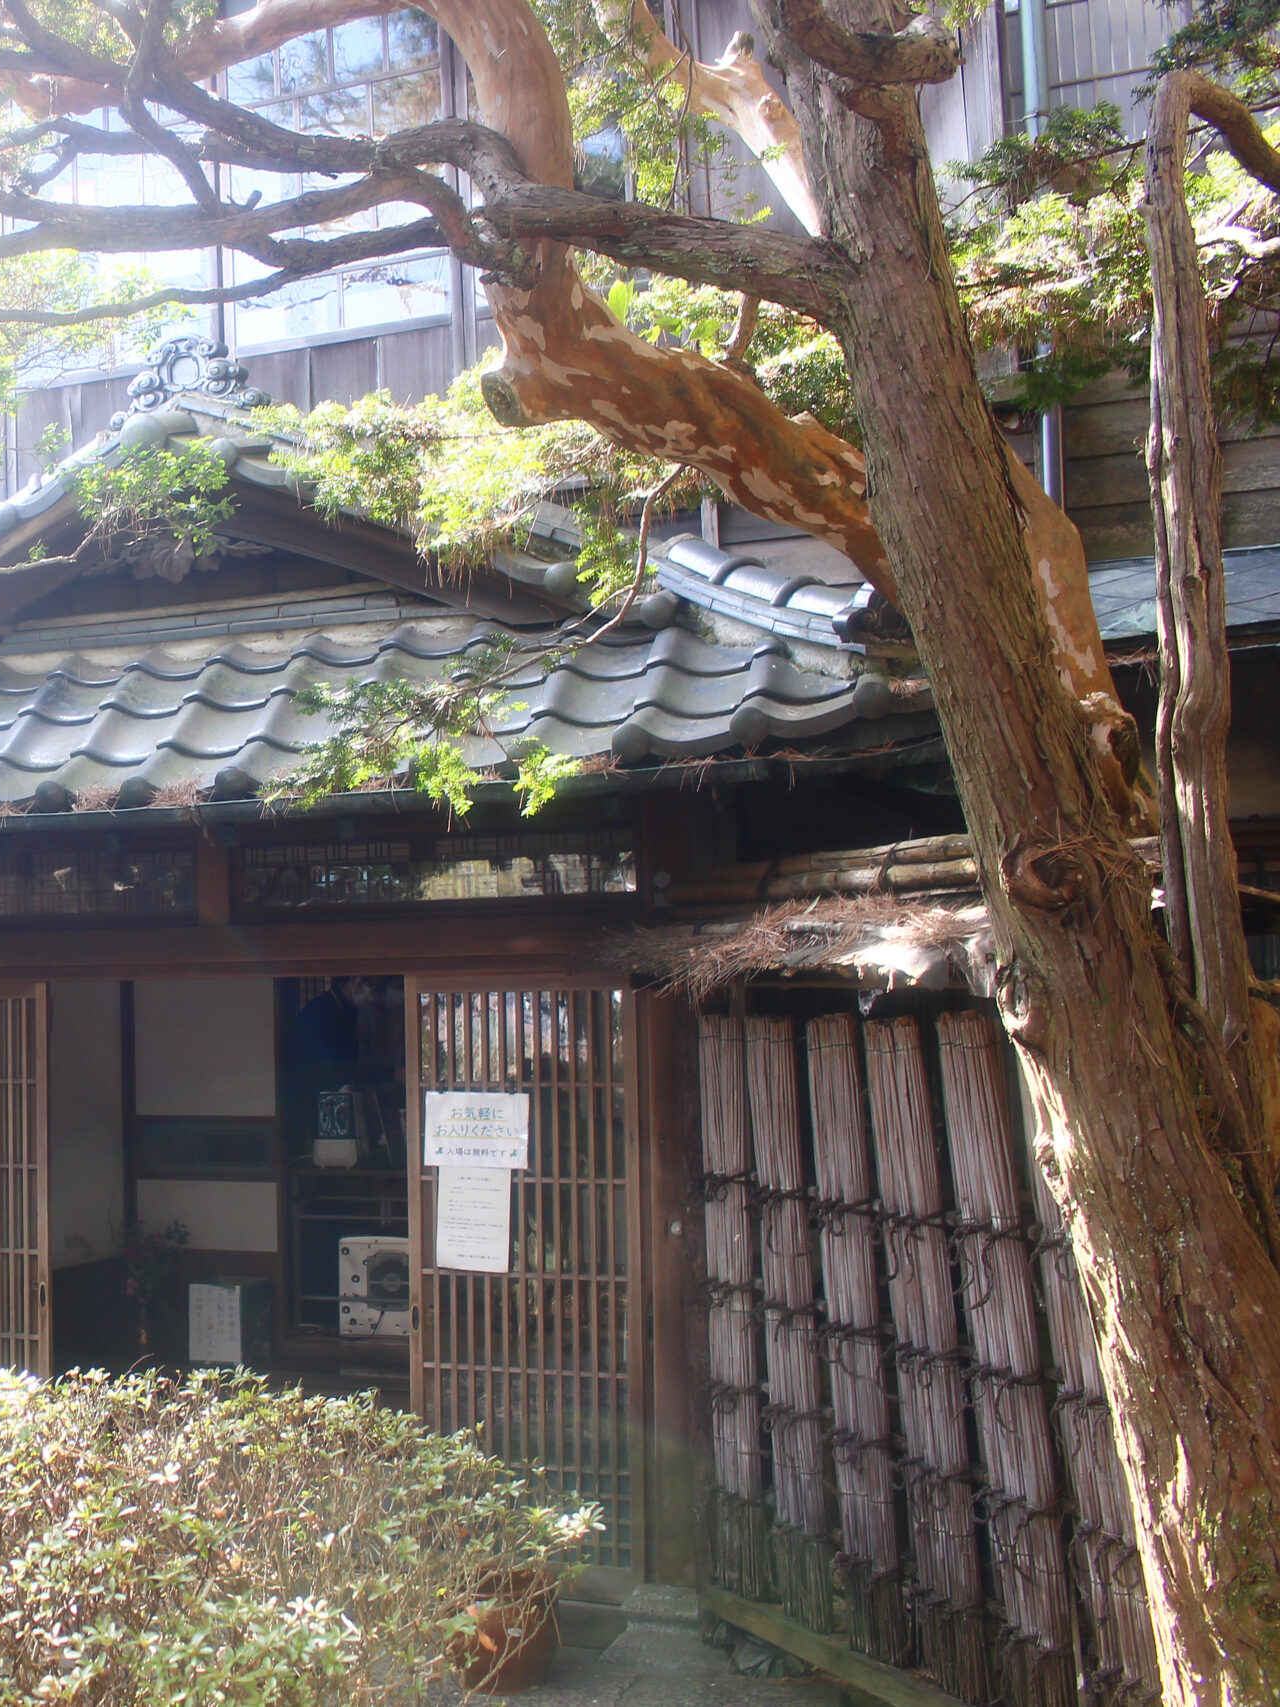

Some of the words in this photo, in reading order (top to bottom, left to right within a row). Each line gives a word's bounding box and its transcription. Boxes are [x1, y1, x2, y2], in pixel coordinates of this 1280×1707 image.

[451, 1107, 504, 1120] お気軽に
[436, 1124, 520, 1138] お入りください
[447, 1147, 506, 1157] 入場は無料です
